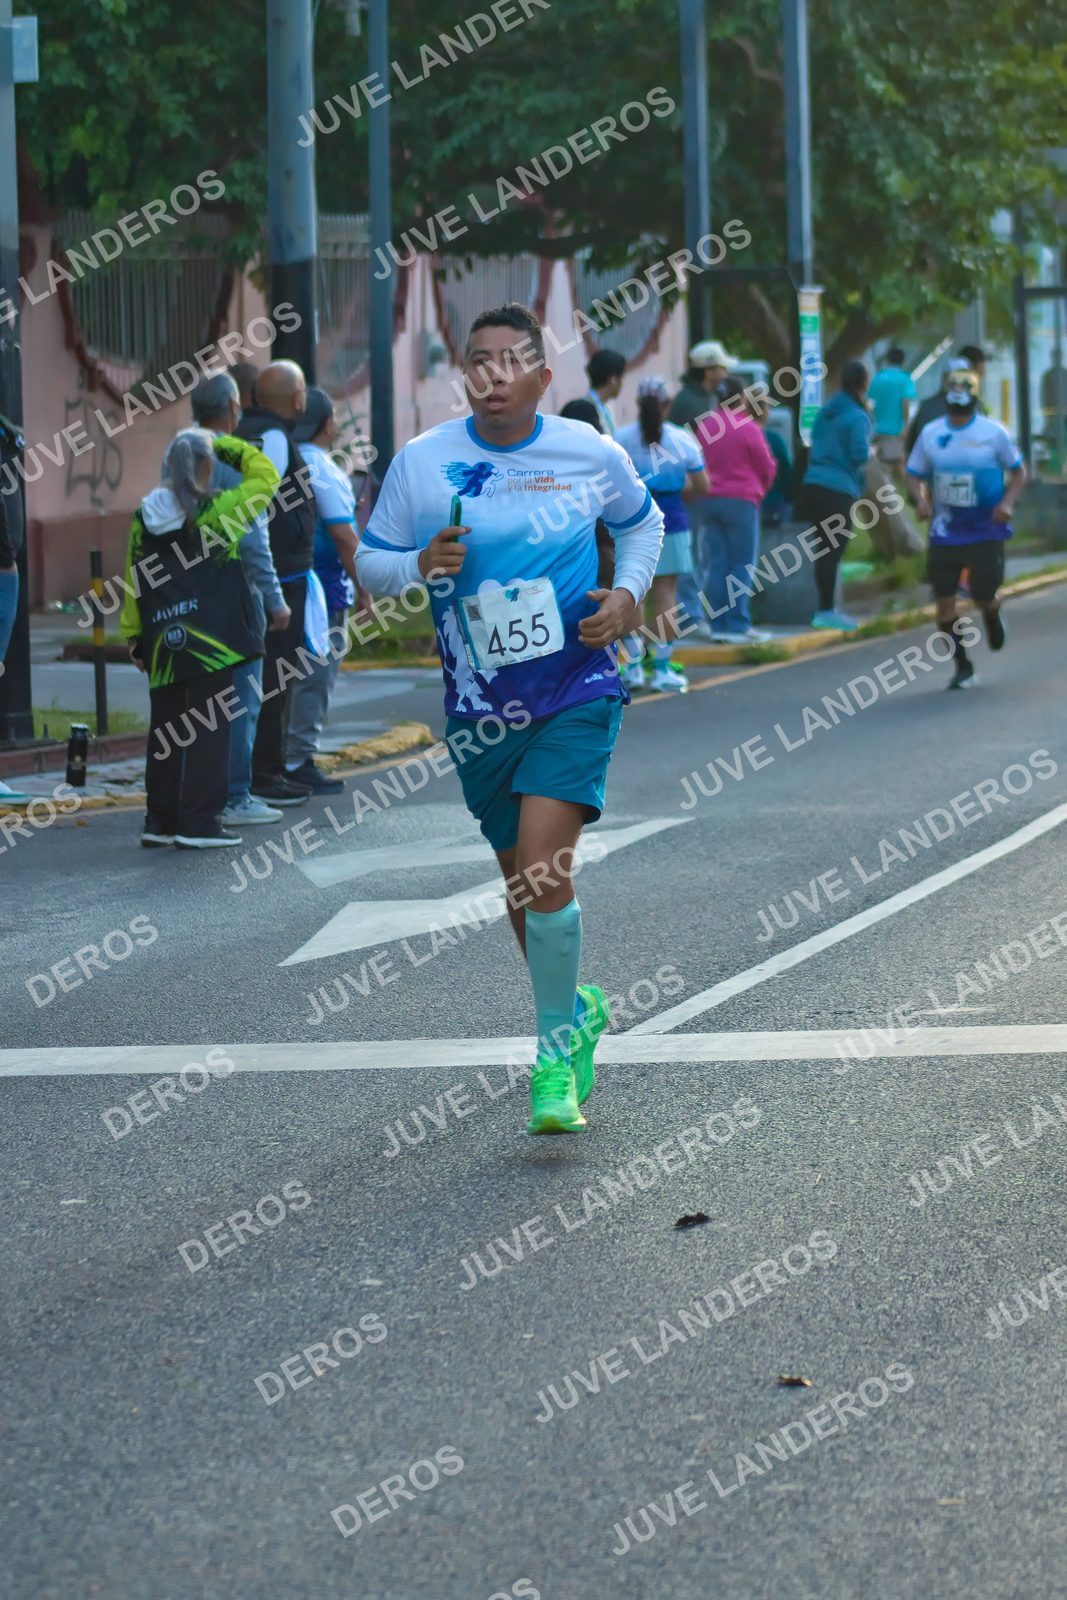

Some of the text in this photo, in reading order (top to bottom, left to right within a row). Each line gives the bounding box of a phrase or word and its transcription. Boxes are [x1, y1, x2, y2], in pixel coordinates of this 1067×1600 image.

[507, 468, 554, 478] Carrera
[534, 476, 555, 484] Vida
[525, 484, 572, 493] Integridad
[487, 612, 550, 656] 455
